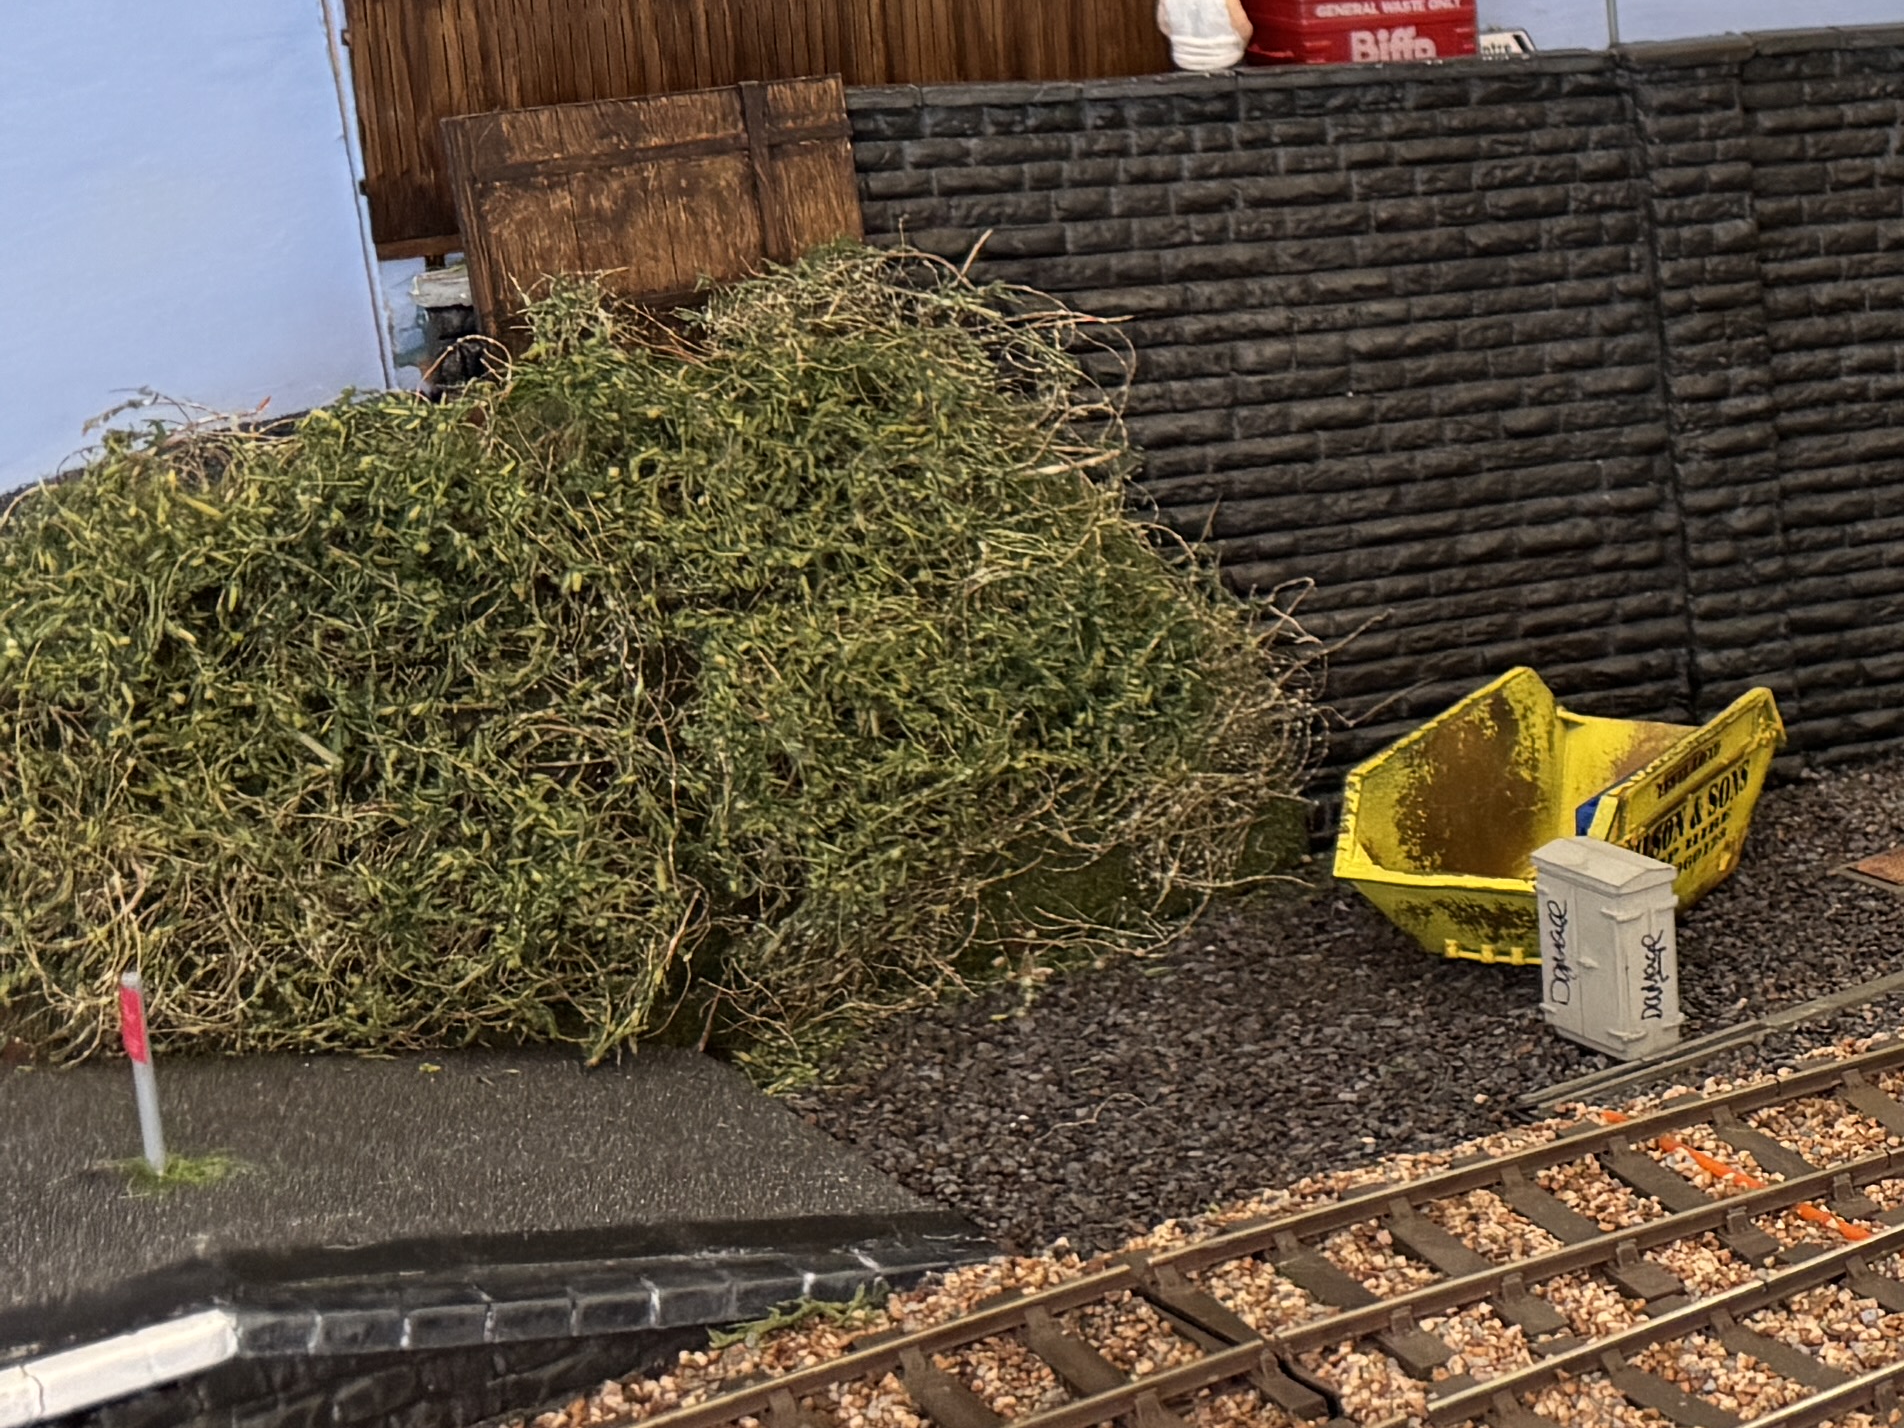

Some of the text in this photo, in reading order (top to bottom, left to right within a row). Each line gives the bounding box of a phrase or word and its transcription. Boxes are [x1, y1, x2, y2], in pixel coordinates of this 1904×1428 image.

[1315, 1, 1380, 18] GENERAL
[1351, 25, 1437, 63] Biffa
[1707, 759, 1751, 815] SONS
